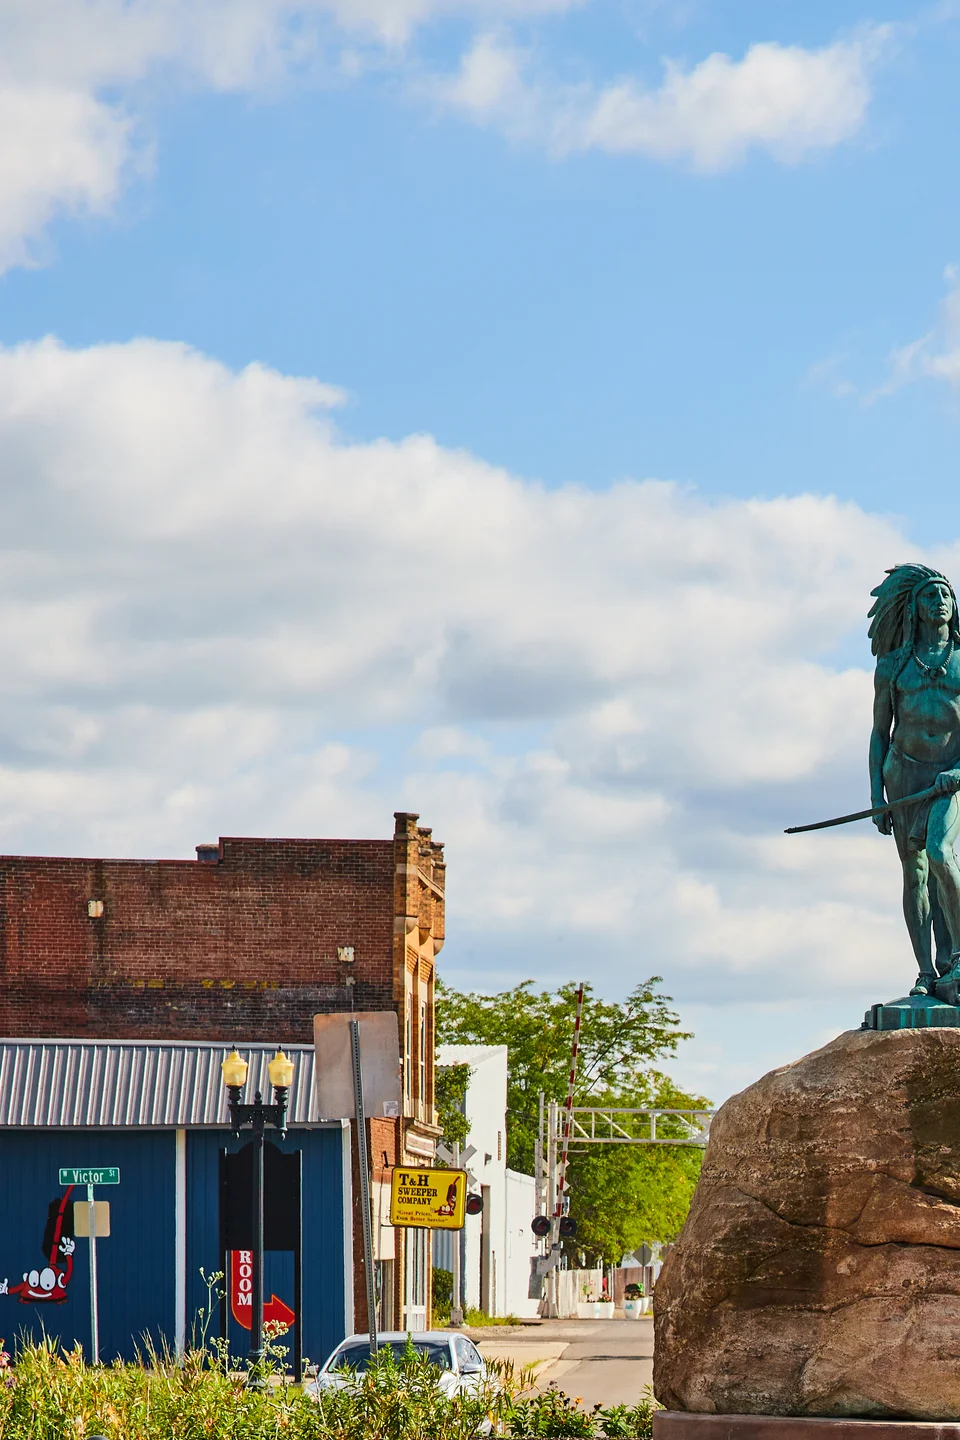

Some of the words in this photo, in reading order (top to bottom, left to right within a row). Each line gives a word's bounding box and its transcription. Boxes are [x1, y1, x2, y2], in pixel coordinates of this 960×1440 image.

[72, 1169, 104, 1183] Victor
[108, 1169, 115, 1177] St
[398, 1173, 430, 1186] T&H
[397, 1186, 438, 1197] SWEEPER
[397, 1196, 432, 1206] COMPANY
[237, 1250, 253, 1306] ROOM
